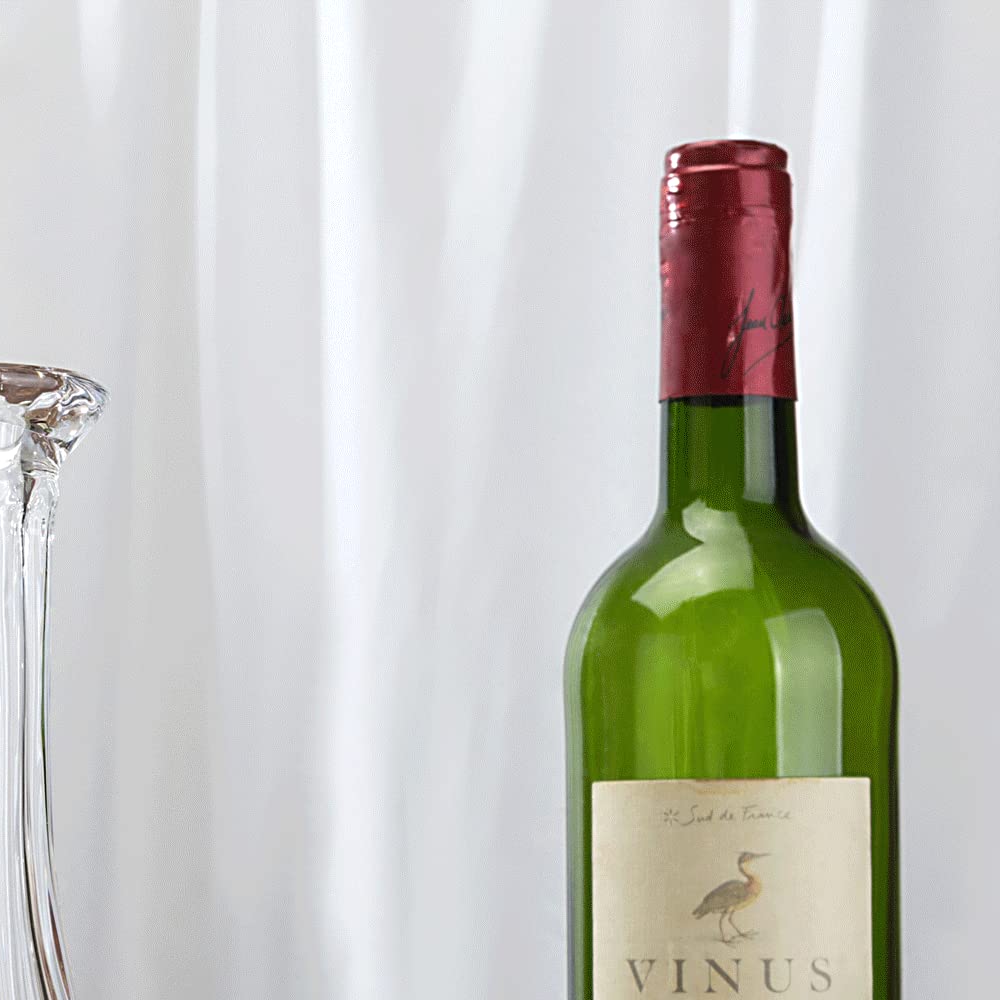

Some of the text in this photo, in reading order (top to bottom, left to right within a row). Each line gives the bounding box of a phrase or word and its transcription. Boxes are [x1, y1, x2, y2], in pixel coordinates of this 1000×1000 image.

[679, 804, 794, 826] Sud de France
[626, 957, 832, 994] VINUS
